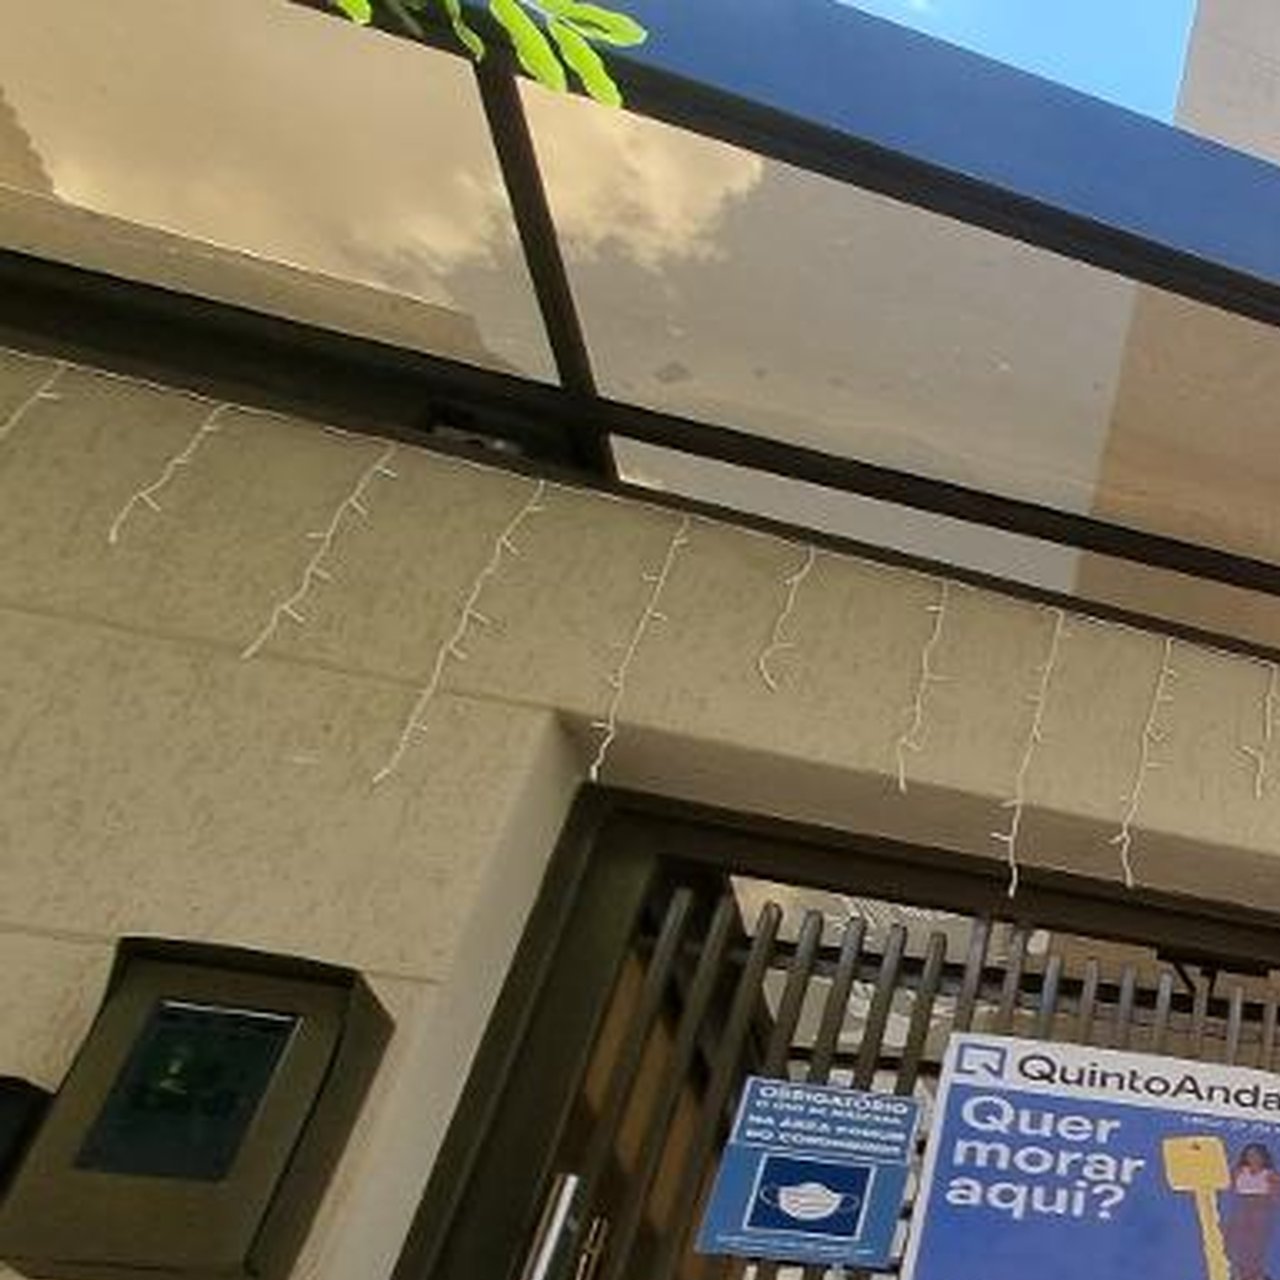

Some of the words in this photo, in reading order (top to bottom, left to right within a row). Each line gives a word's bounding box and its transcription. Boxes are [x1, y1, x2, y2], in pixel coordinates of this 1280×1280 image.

[959, 1095, 1121, 1144] Quer
[952, 1140, 1147, 1184] morar
[945, 1176, 1126, 1219] aqui?
